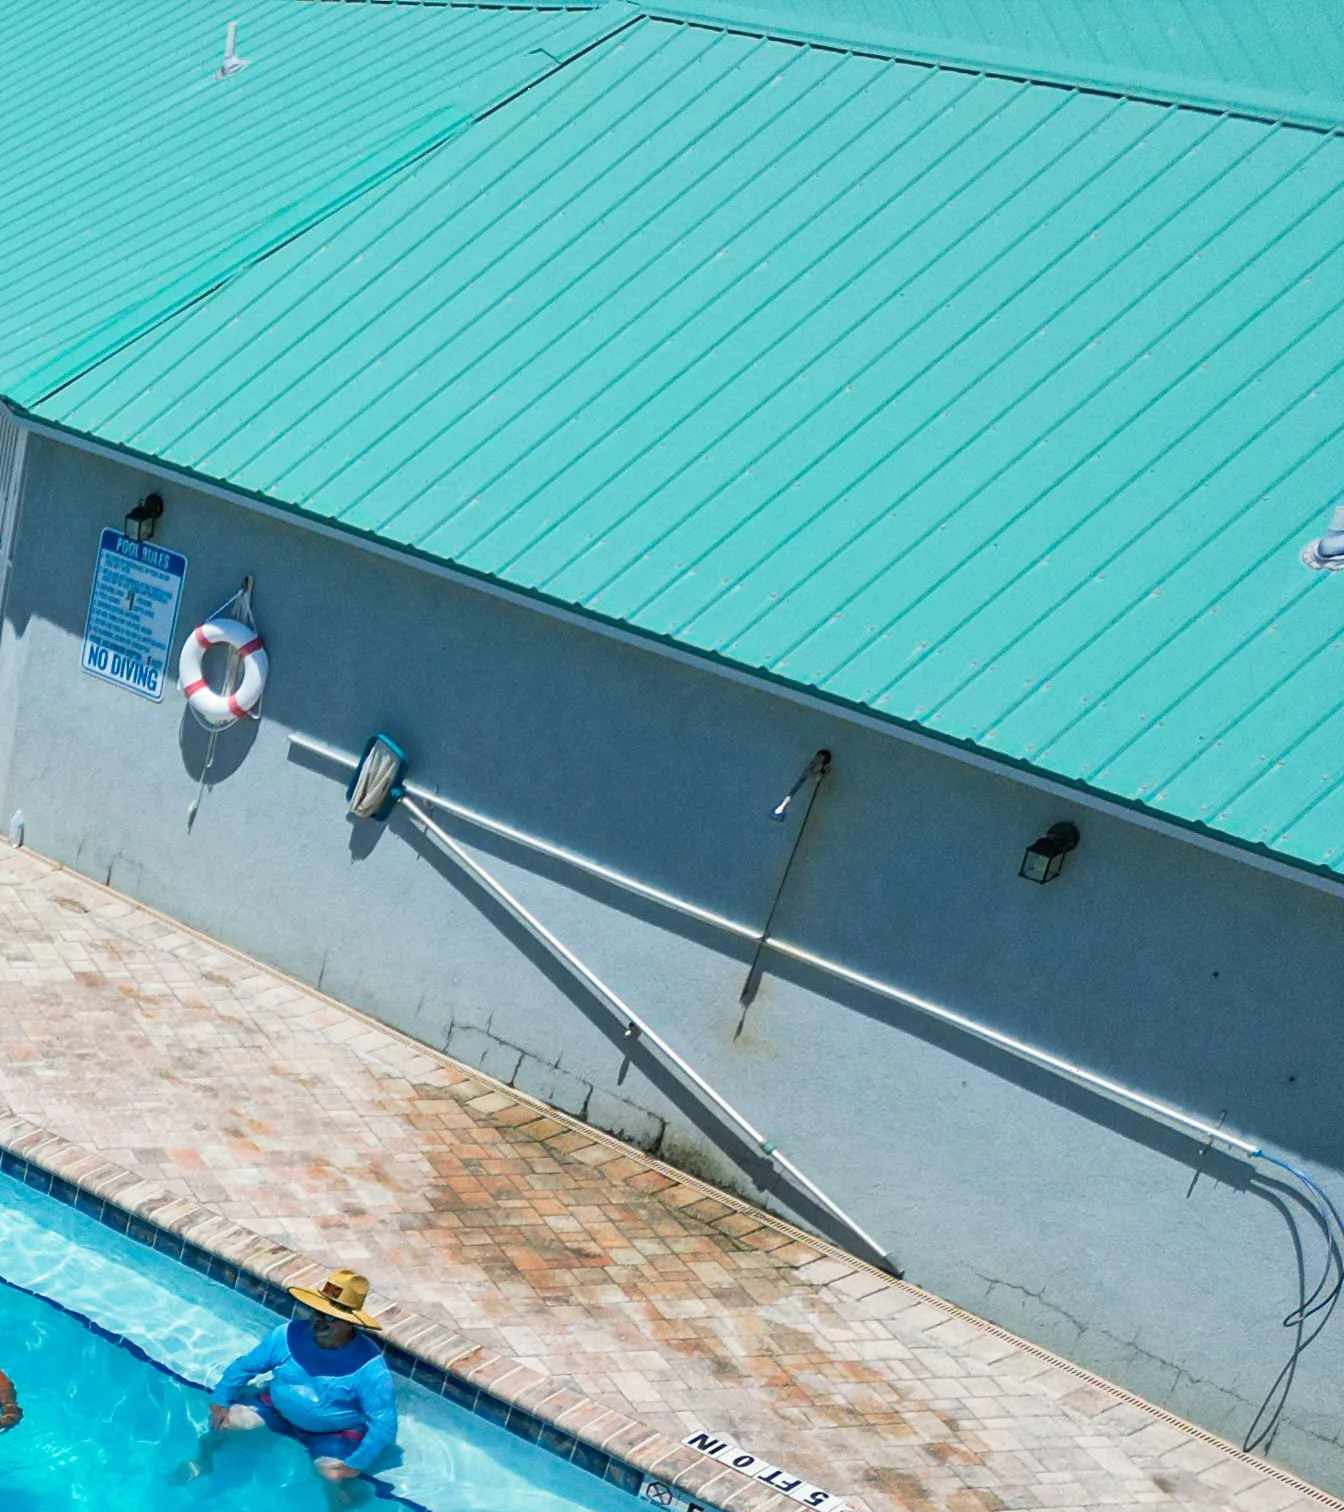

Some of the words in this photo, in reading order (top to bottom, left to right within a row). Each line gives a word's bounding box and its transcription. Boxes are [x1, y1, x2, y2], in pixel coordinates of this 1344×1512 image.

[116, 537, 140, 558] POOL
[142, 546, 171, 569] RULES
[87, 644, 109, 671] NO
[111, 653, 159, 692] DIVING
[687, 1433, 728, 1457] IN
[732, 1455, 755, 1468] 0
[758, 1470, 802, 1493] FT
[803, 1491, 830, 1507] 5
